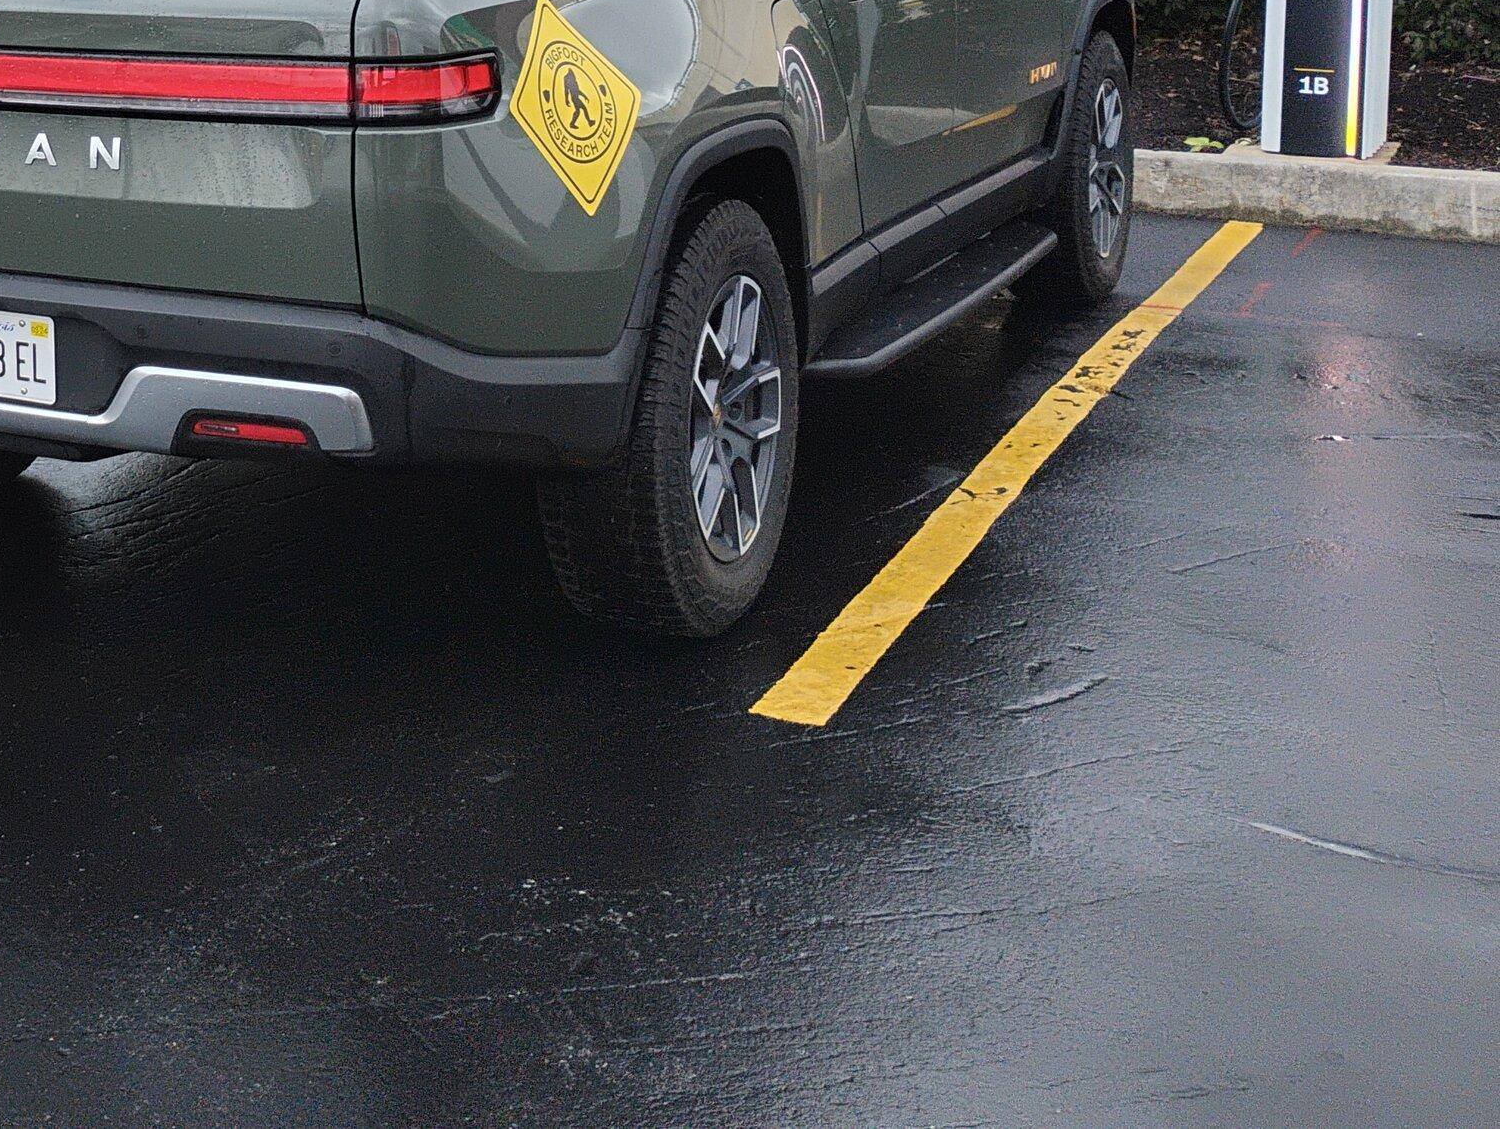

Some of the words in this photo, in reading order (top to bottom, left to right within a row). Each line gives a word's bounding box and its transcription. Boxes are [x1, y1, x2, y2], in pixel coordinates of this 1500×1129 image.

[545, 47, 585, 70] BIGFOOT
[1298, 75, 1330, 95] 1B
[545, 108, 599, 158] RESEARCH
[597, 102, 614, 145] TEAM
[15, 340, 47, 384] EL
